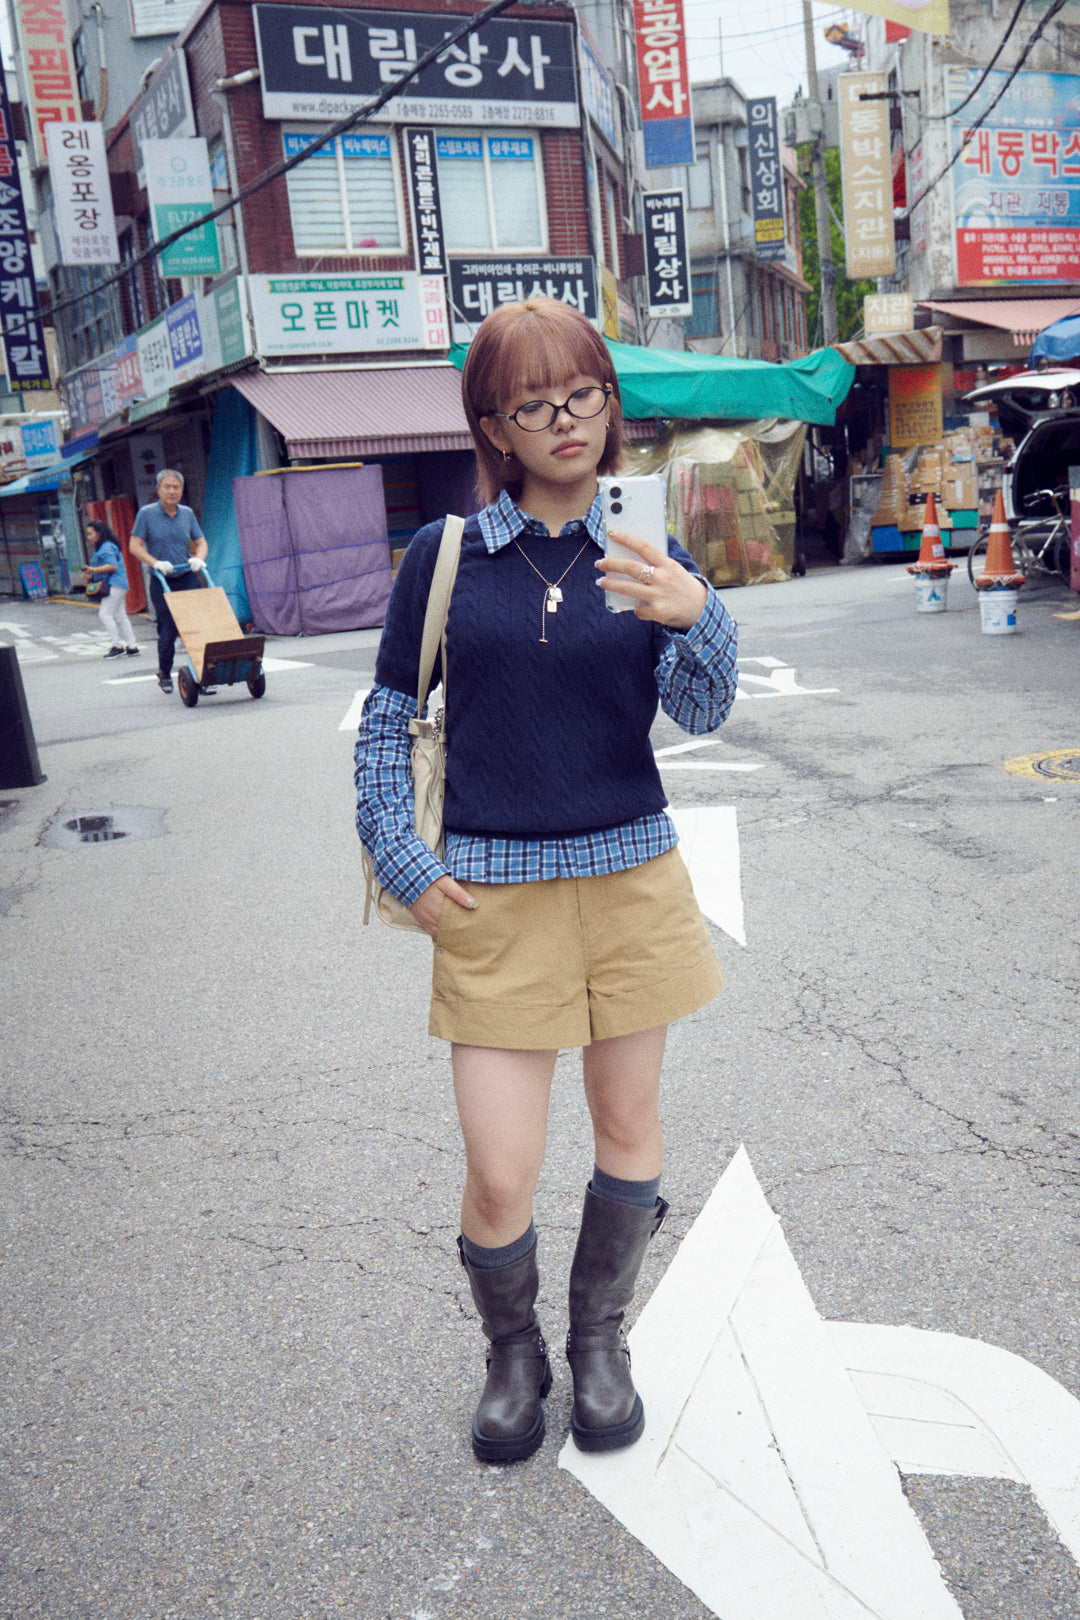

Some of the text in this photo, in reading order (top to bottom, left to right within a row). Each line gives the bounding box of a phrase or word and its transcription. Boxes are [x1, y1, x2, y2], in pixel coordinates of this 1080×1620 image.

[293, 24, 550, 89] 대림상사
[62, 129, 101, 230] 레옹포장
[752, 103, 779, 213] 의신상회
[849, 81, 889, 241] 대동박스지관
[0, 209, 43, 375] 조양케미칼
[651, 211, 684, 300] 대림상사
[280, 299, 400, 332] 오픈마켓
